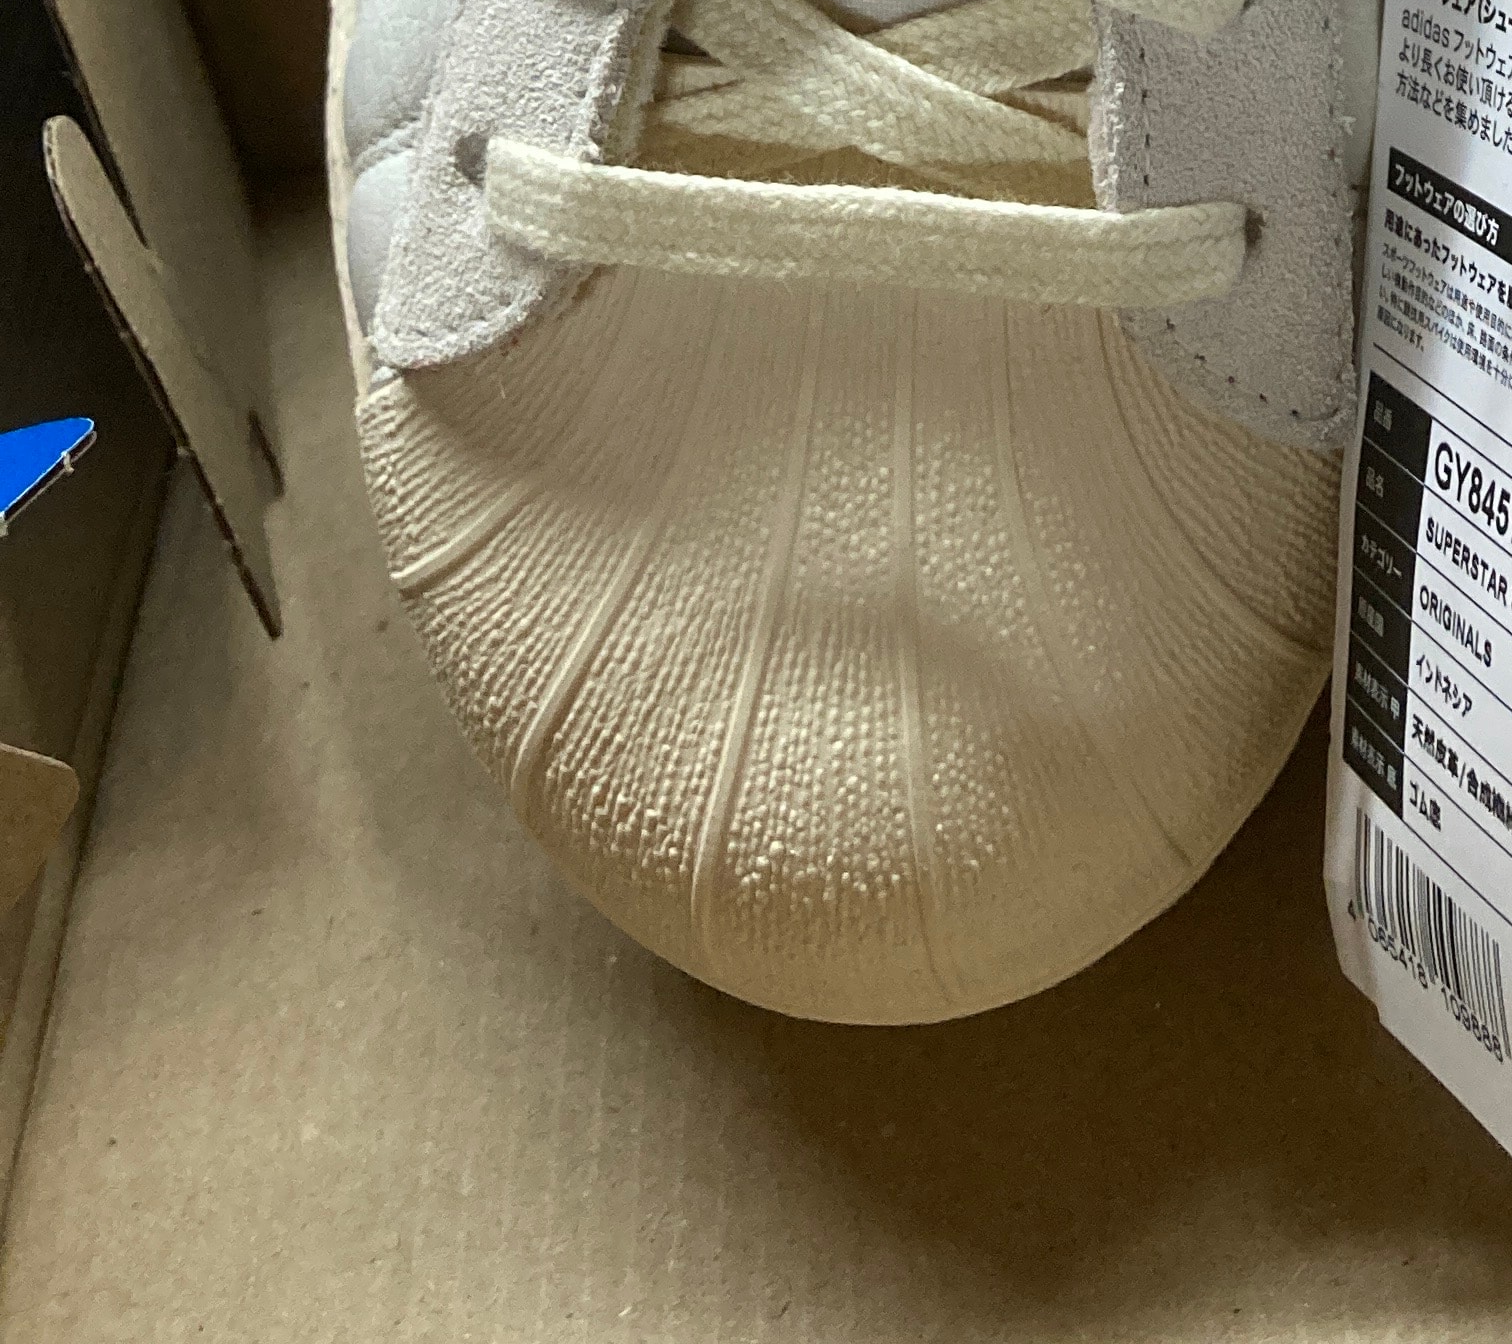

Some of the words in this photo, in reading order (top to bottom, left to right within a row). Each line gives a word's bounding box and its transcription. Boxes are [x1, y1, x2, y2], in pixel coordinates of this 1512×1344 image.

[1401, 9, 1451, 50] adidas
[1425, 515, 1508, 608] SUPERSTAR
[1419, 583, 1493, 668] ORIGINALS
[1415, 652, 1473, 717] インドネシア
